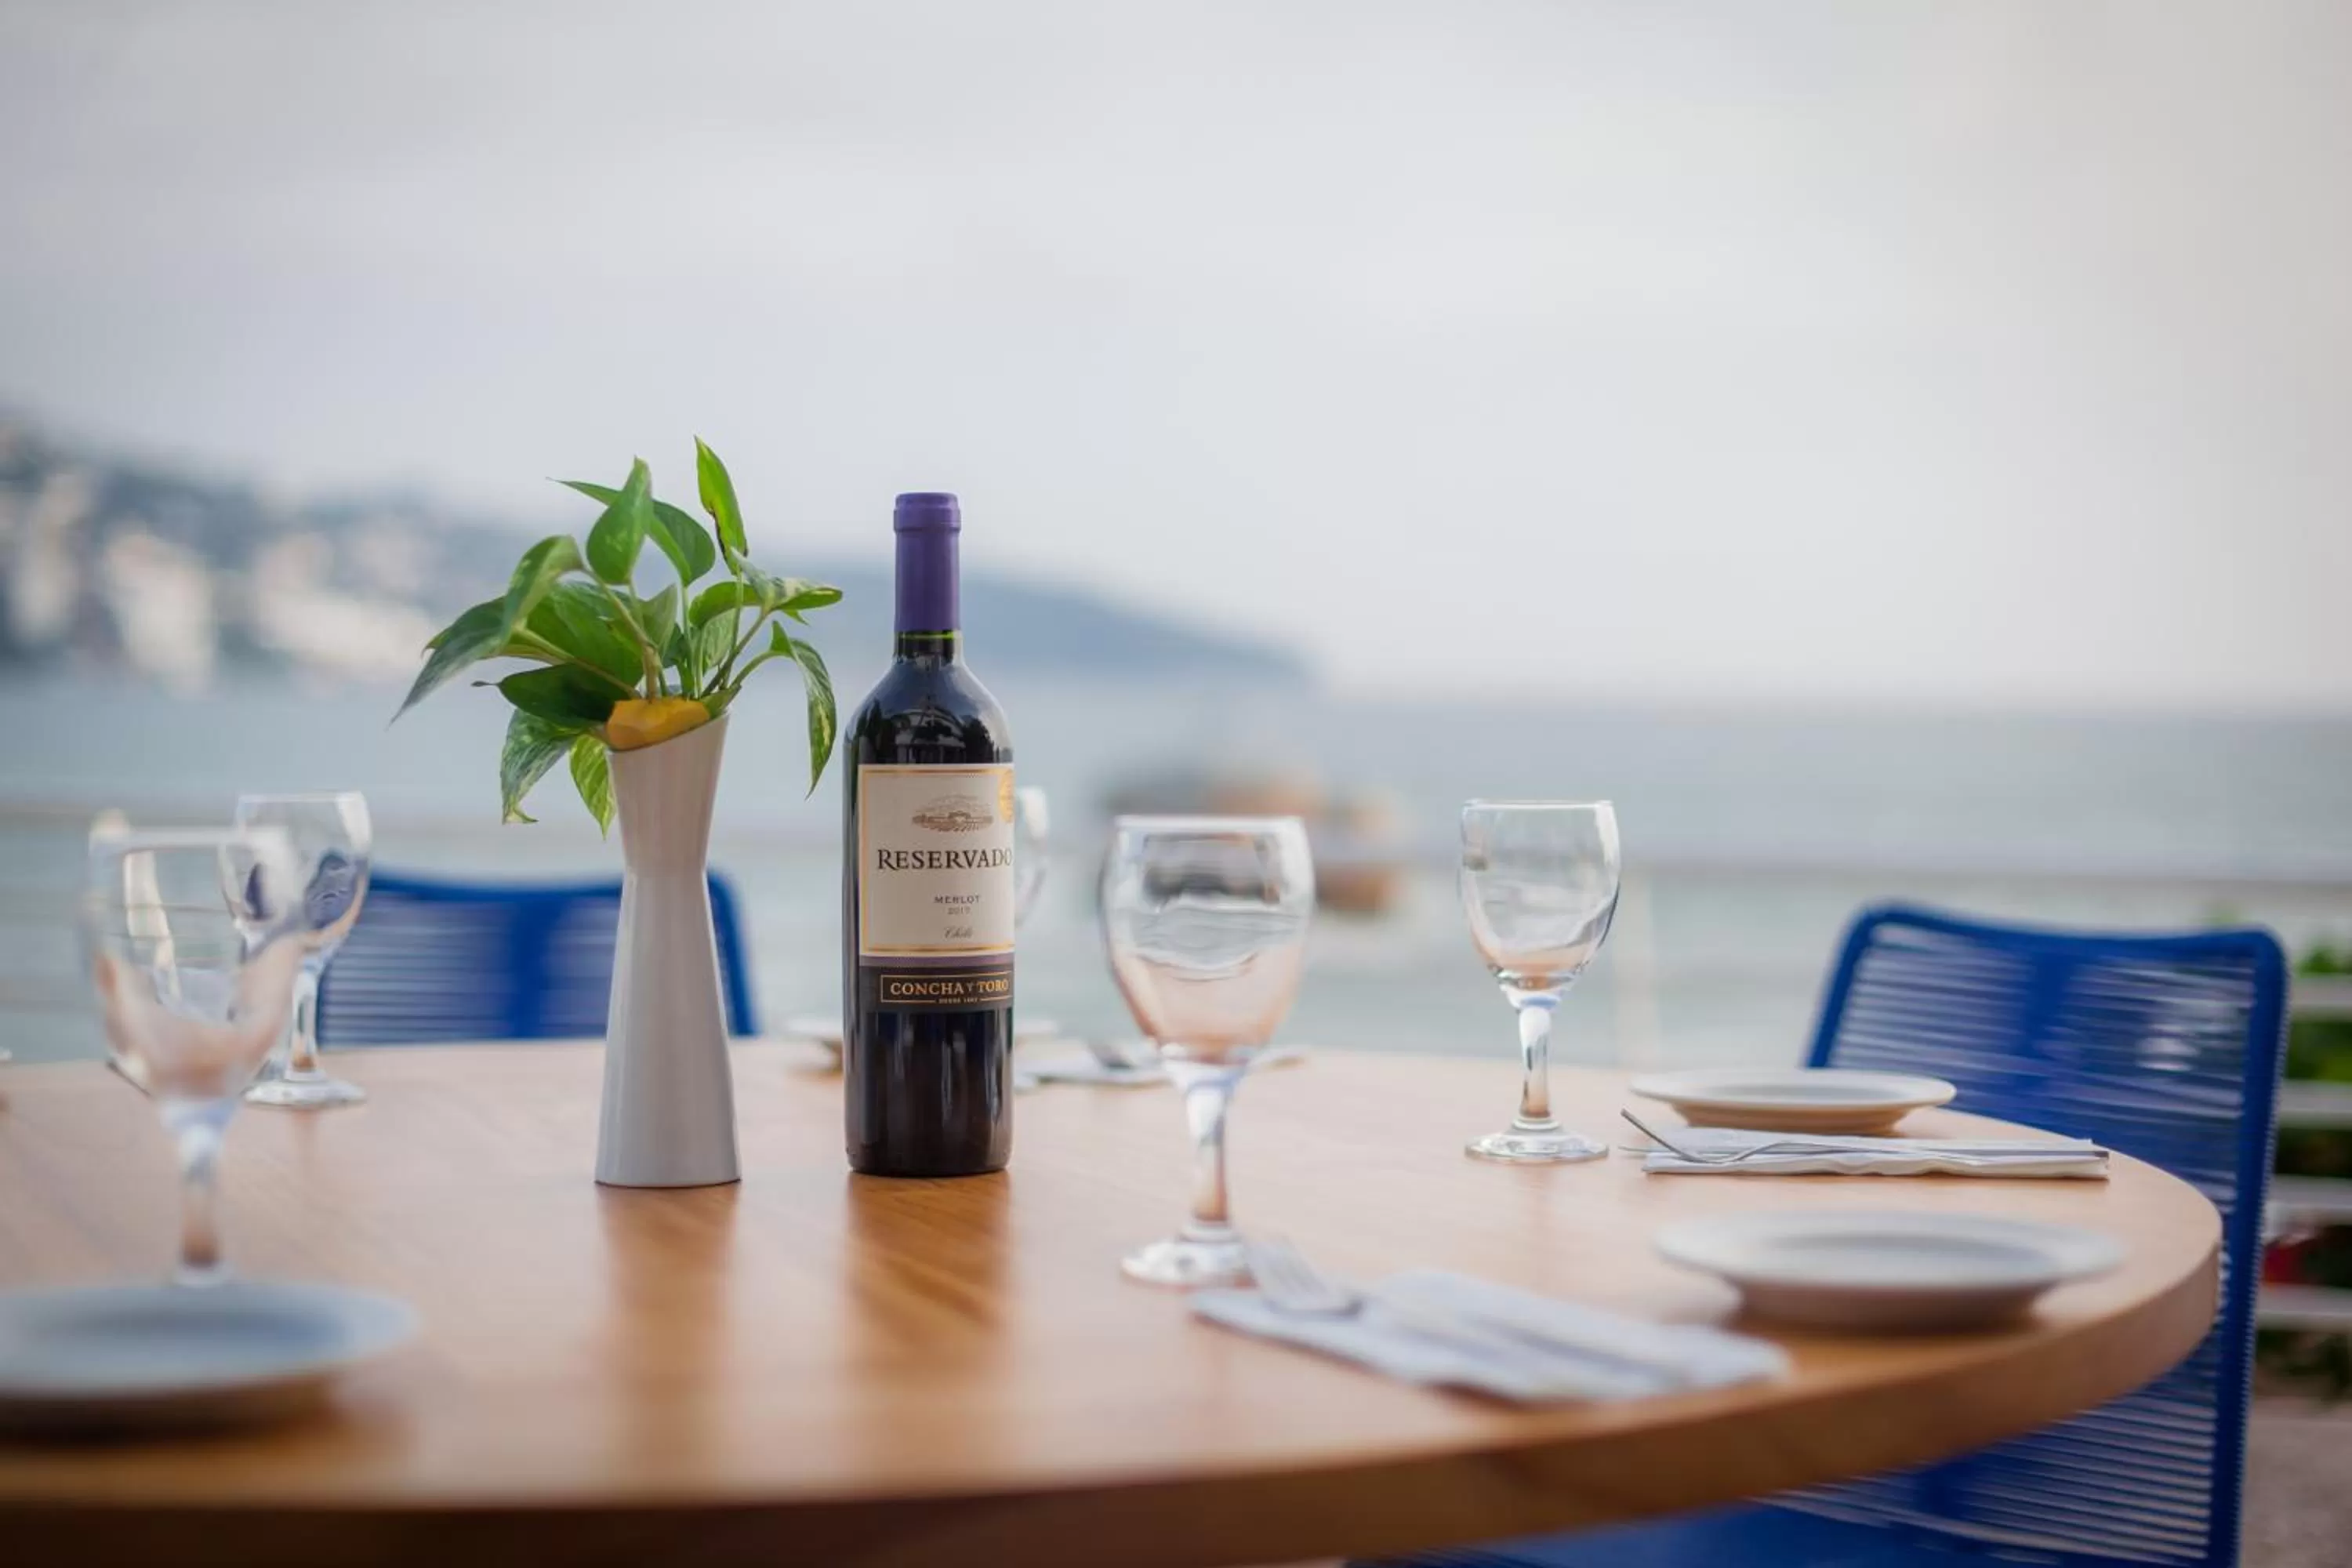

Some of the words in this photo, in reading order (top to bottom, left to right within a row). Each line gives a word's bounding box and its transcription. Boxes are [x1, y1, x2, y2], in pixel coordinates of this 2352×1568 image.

[877, 848, 1012, 870] RESERVADO
[934, 895, 980, 904] MERLOT
[890, 982, 964, 995] CONCHA
[967, 982, 974, 992] Y
[977, 978, 1009, 993] TORO
